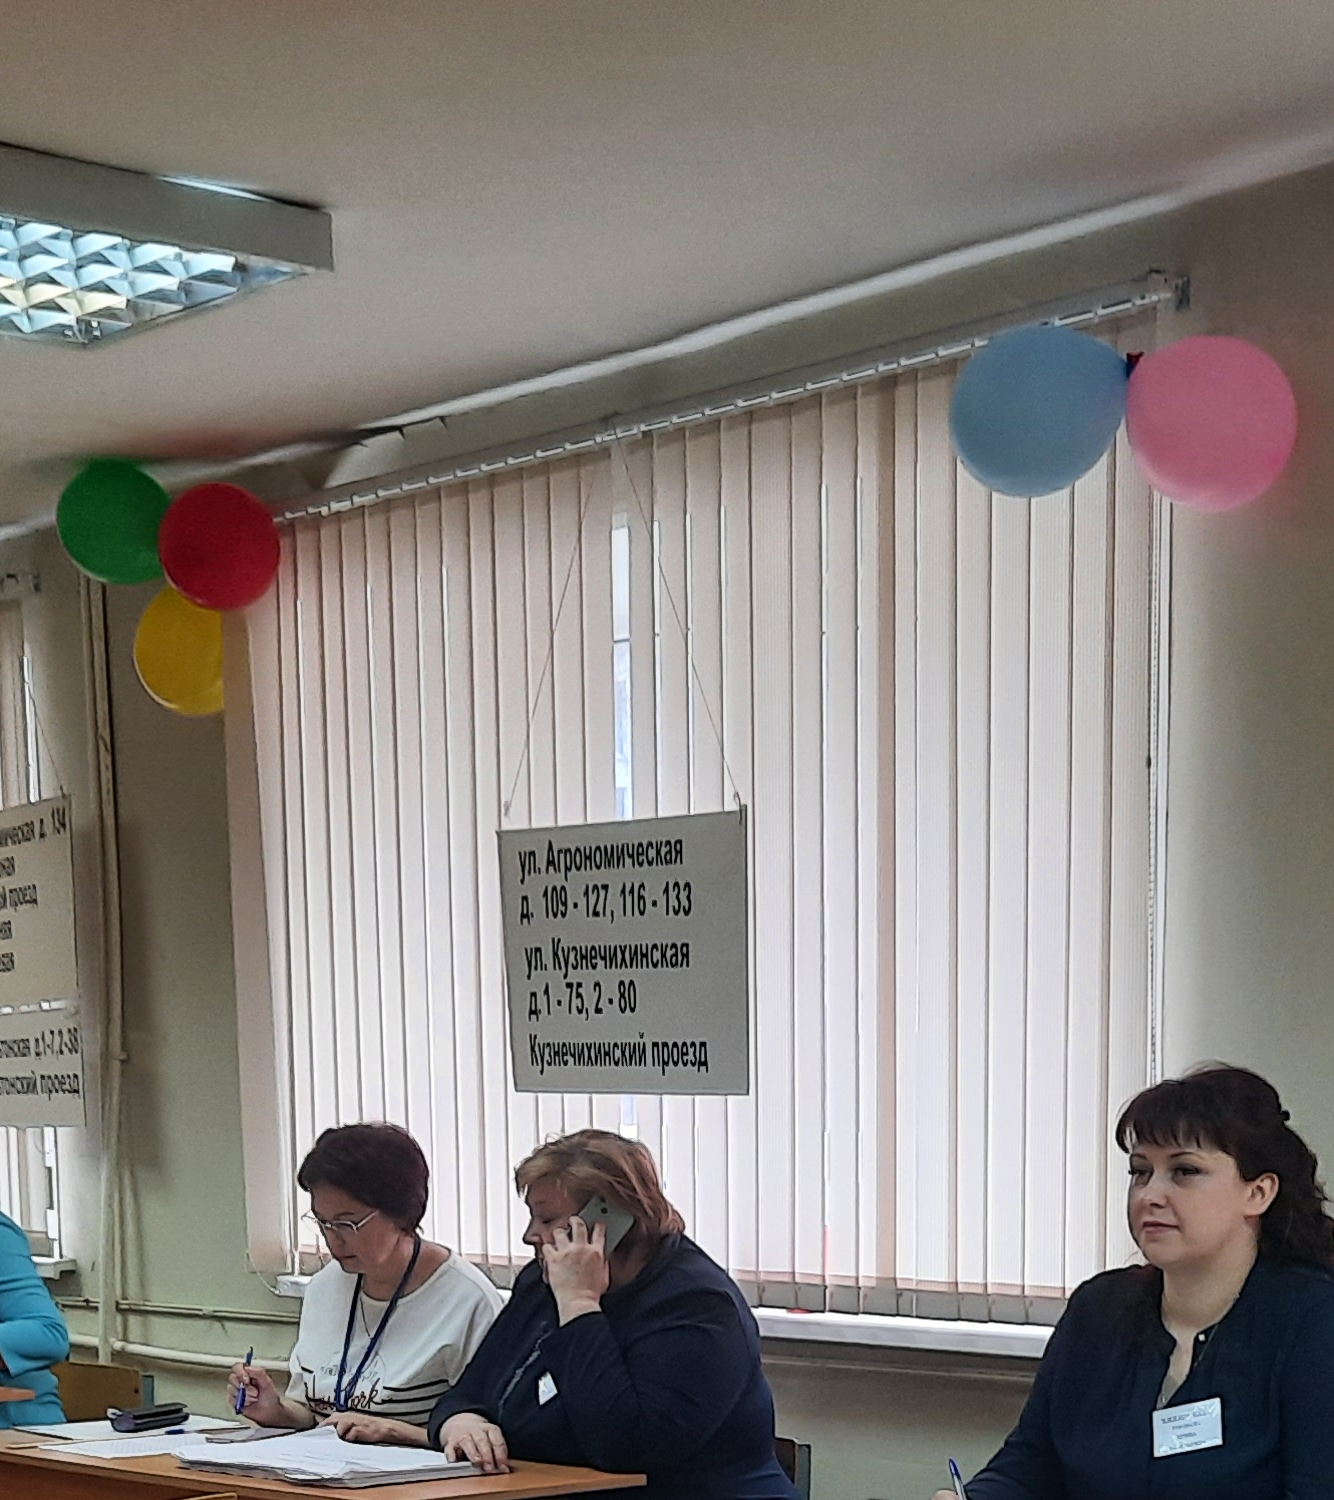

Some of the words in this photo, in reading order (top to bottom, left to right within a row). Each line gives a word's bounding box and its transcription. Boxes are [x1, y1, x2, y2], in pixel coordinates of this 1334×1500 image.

[518, 849, 542, 885] ул.
[545, 838, 683, 882] Агрономическая
[520, 893, 535, 925] д.
[543, 885, 568, 920] 109
[583, 883, 615, 924] 127,
[620, 881, 646, 917] 116
[663, 880, 692, 917] 133
[525, 946, 548, 980] ул.
[551, 937, 690, 979] Кузнечихинская
[618, 979, 637, 1014] 80
[529, 1031, 647, 1075] Кузнечихинский
[652, 1039, 709, 1076] проезд
